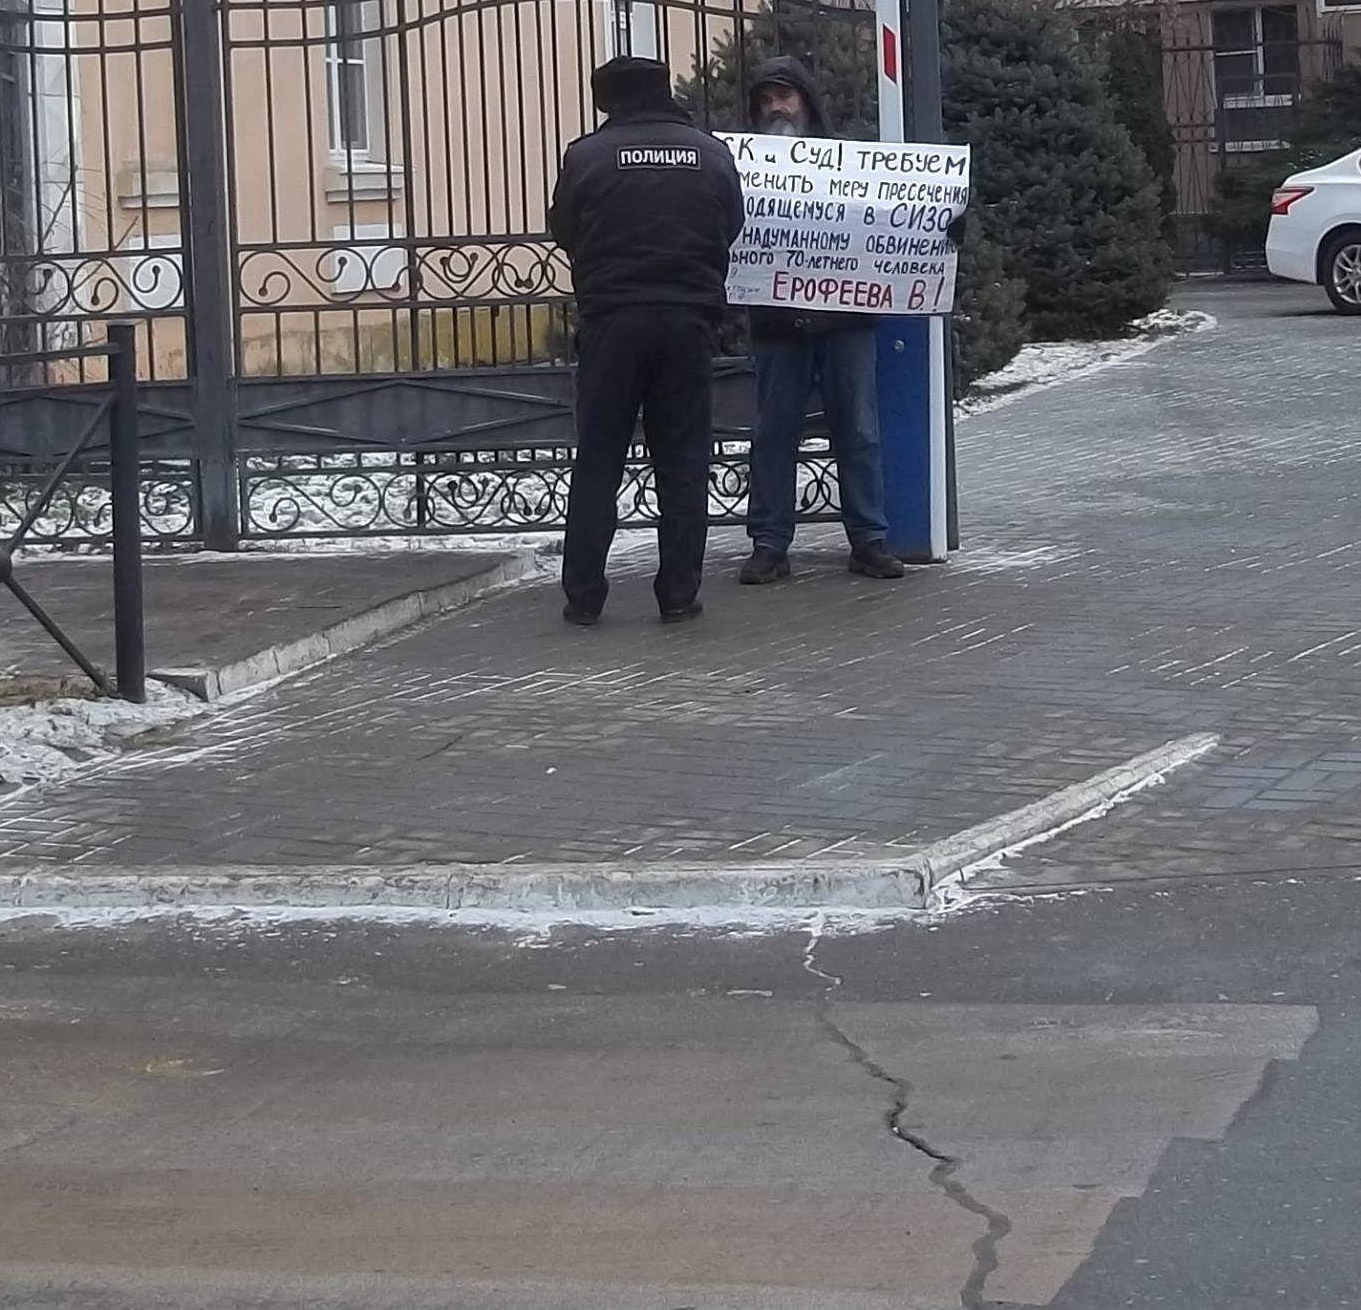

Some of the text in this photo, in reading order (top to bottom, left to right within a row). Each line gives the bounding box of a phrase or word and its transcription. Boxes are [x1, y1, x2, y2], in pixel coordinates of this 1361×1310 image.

[621, 150, 696, 165] ПОЛИЦИЯ
[890, 203, 953, 232] СИЗО
[772, 271, 893, 308] ЕРОФЕЕВА
